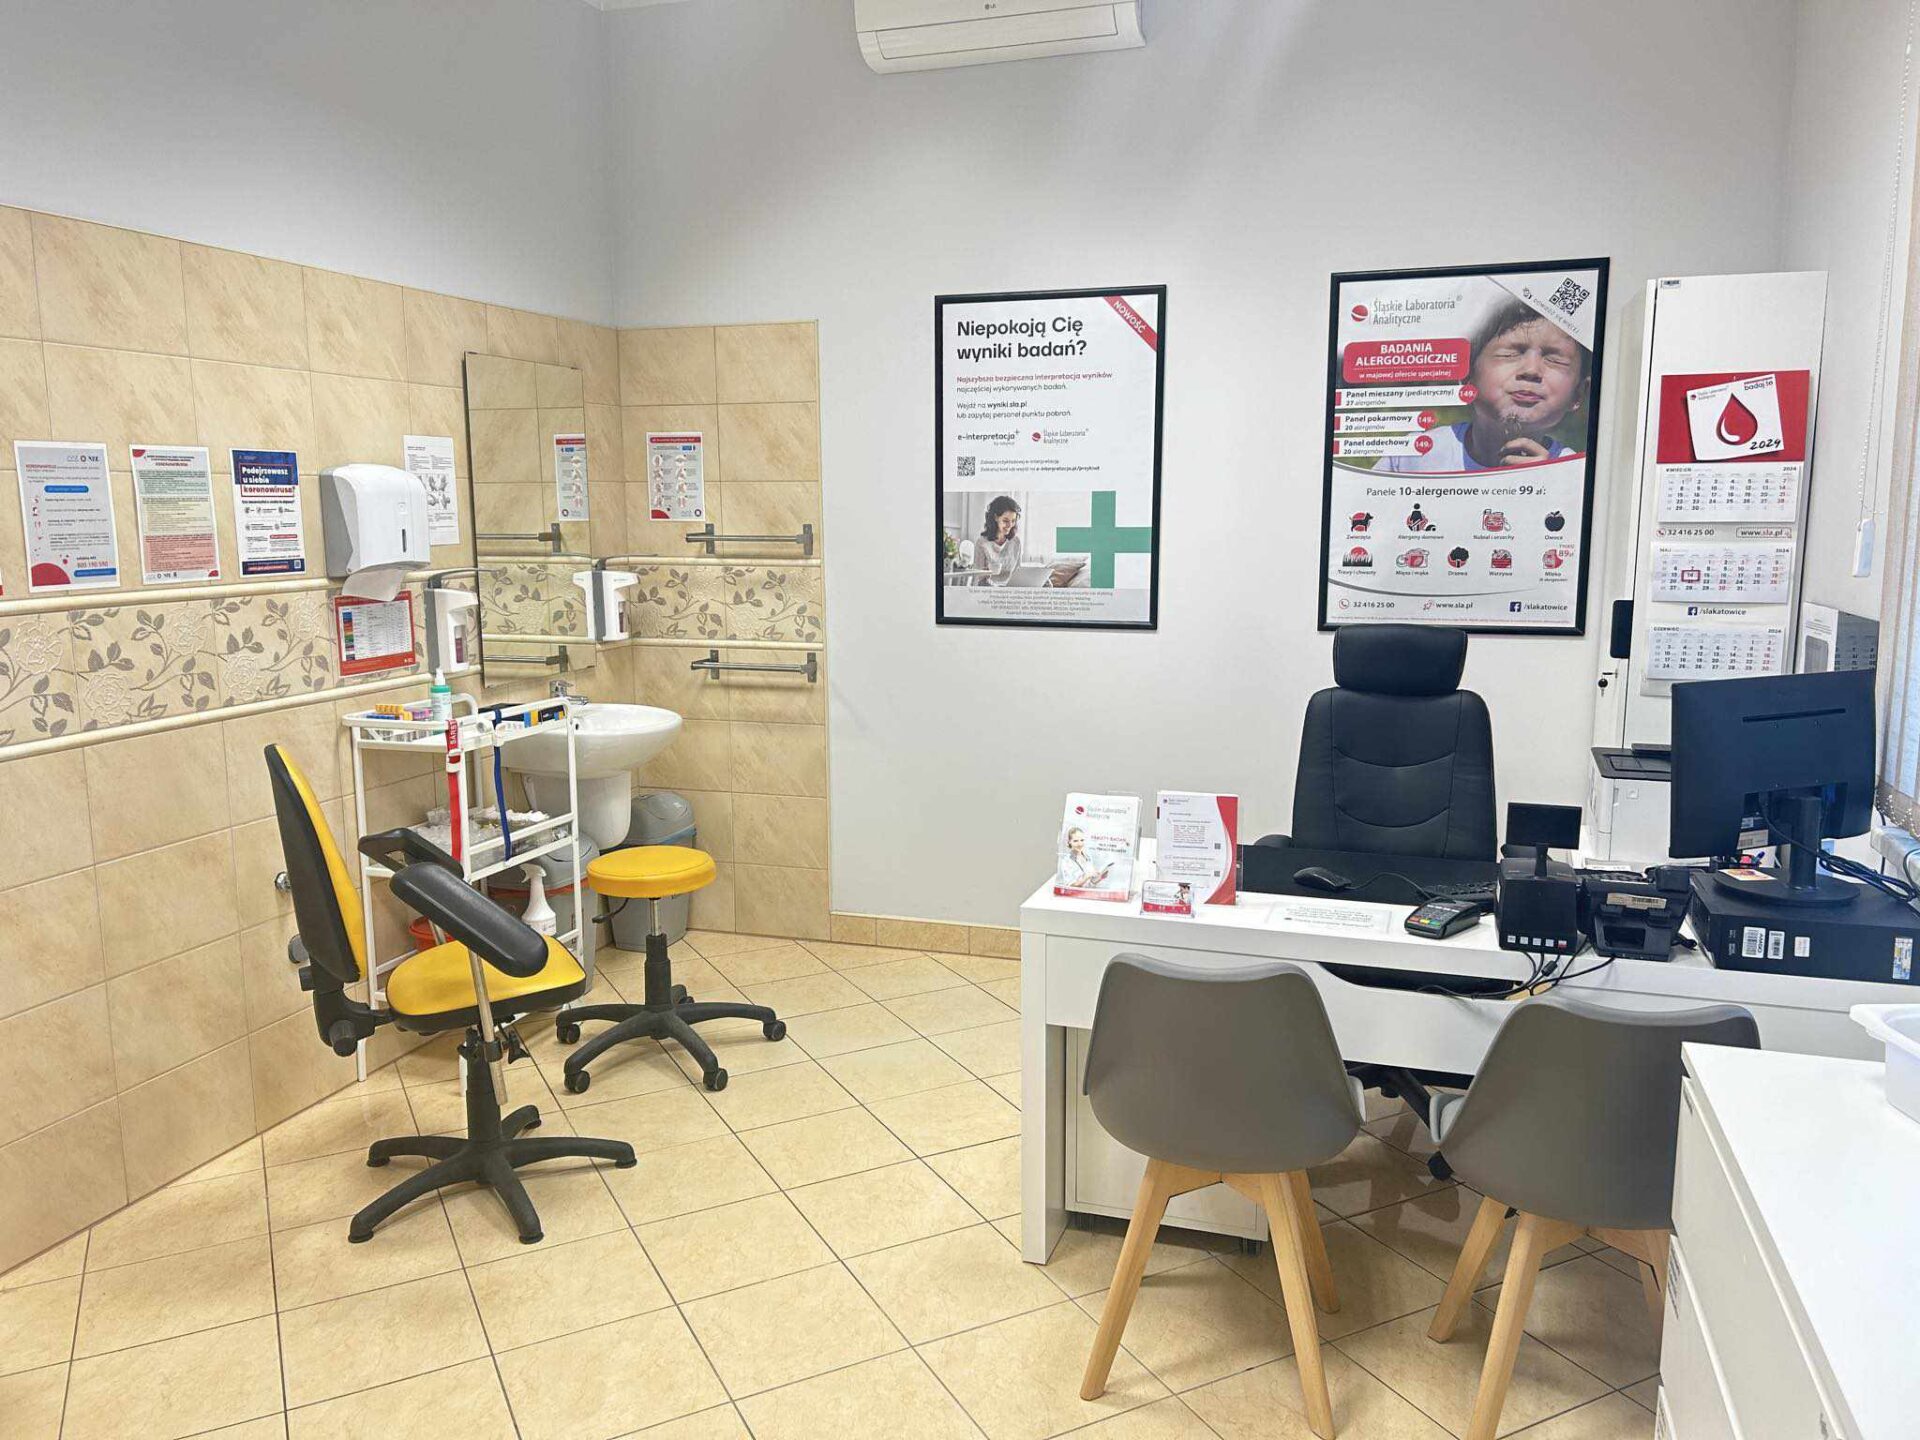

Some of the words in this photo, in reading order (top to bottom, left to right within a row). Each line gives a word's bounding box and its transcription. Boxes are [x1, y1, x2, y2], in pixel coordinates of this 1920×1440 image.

[1373, 298, 1402, 313] Śląskie
[1405, 298, 1455, 312] Laboratoria
[1113, 299, 1147, 334] NOWOŚĆ
[1373, 314, 1421, 327] Analityczne
[957, 318, 1046, 339] Niepokoją
[1052, 316, 1083, 337] Cię
[957, 342, 1012, 362] wyniki
[1017, 340, 1087, 358] badań?
[1381, 343, 1432, 354] BADANIA
[1355, 353, 1458, 367] ALERGOLOGICZNE
[995, 374, 1034, 384] bezpieczna
[1035, 373, 1080, 383] interpretacja
[1082, 371, 1113, 381] wyników
[1418, 369, 1451, 379] specjalnej
[1346, 390, 1367, 398] Panel
[1368, 389, 1404, 399] mieszany
[1021, 410, 1045, 419] punktu
[1367, 413, 1413, 423] pokarmowy
[1344, 439, 1365, 447] Panel
[1366, 438, 1409, 448] oddechowy
[1750, 439, 1781, 450] 2024
[242, 466, 288, 477] Podejrzewasz
[1366, 487, 1396, 496] Panele
[1399, 485, 1479, 498] 10-alergenowe
[1492, 487, 1517, 496] cenie
[1519, 486, 1533, 494] 99
[1741, 529, 1783, 537] www.sla.pl
[1524, 603, 1568, 611] /slakatowice
[1699, 608, 1746, 616] /slakatowice
